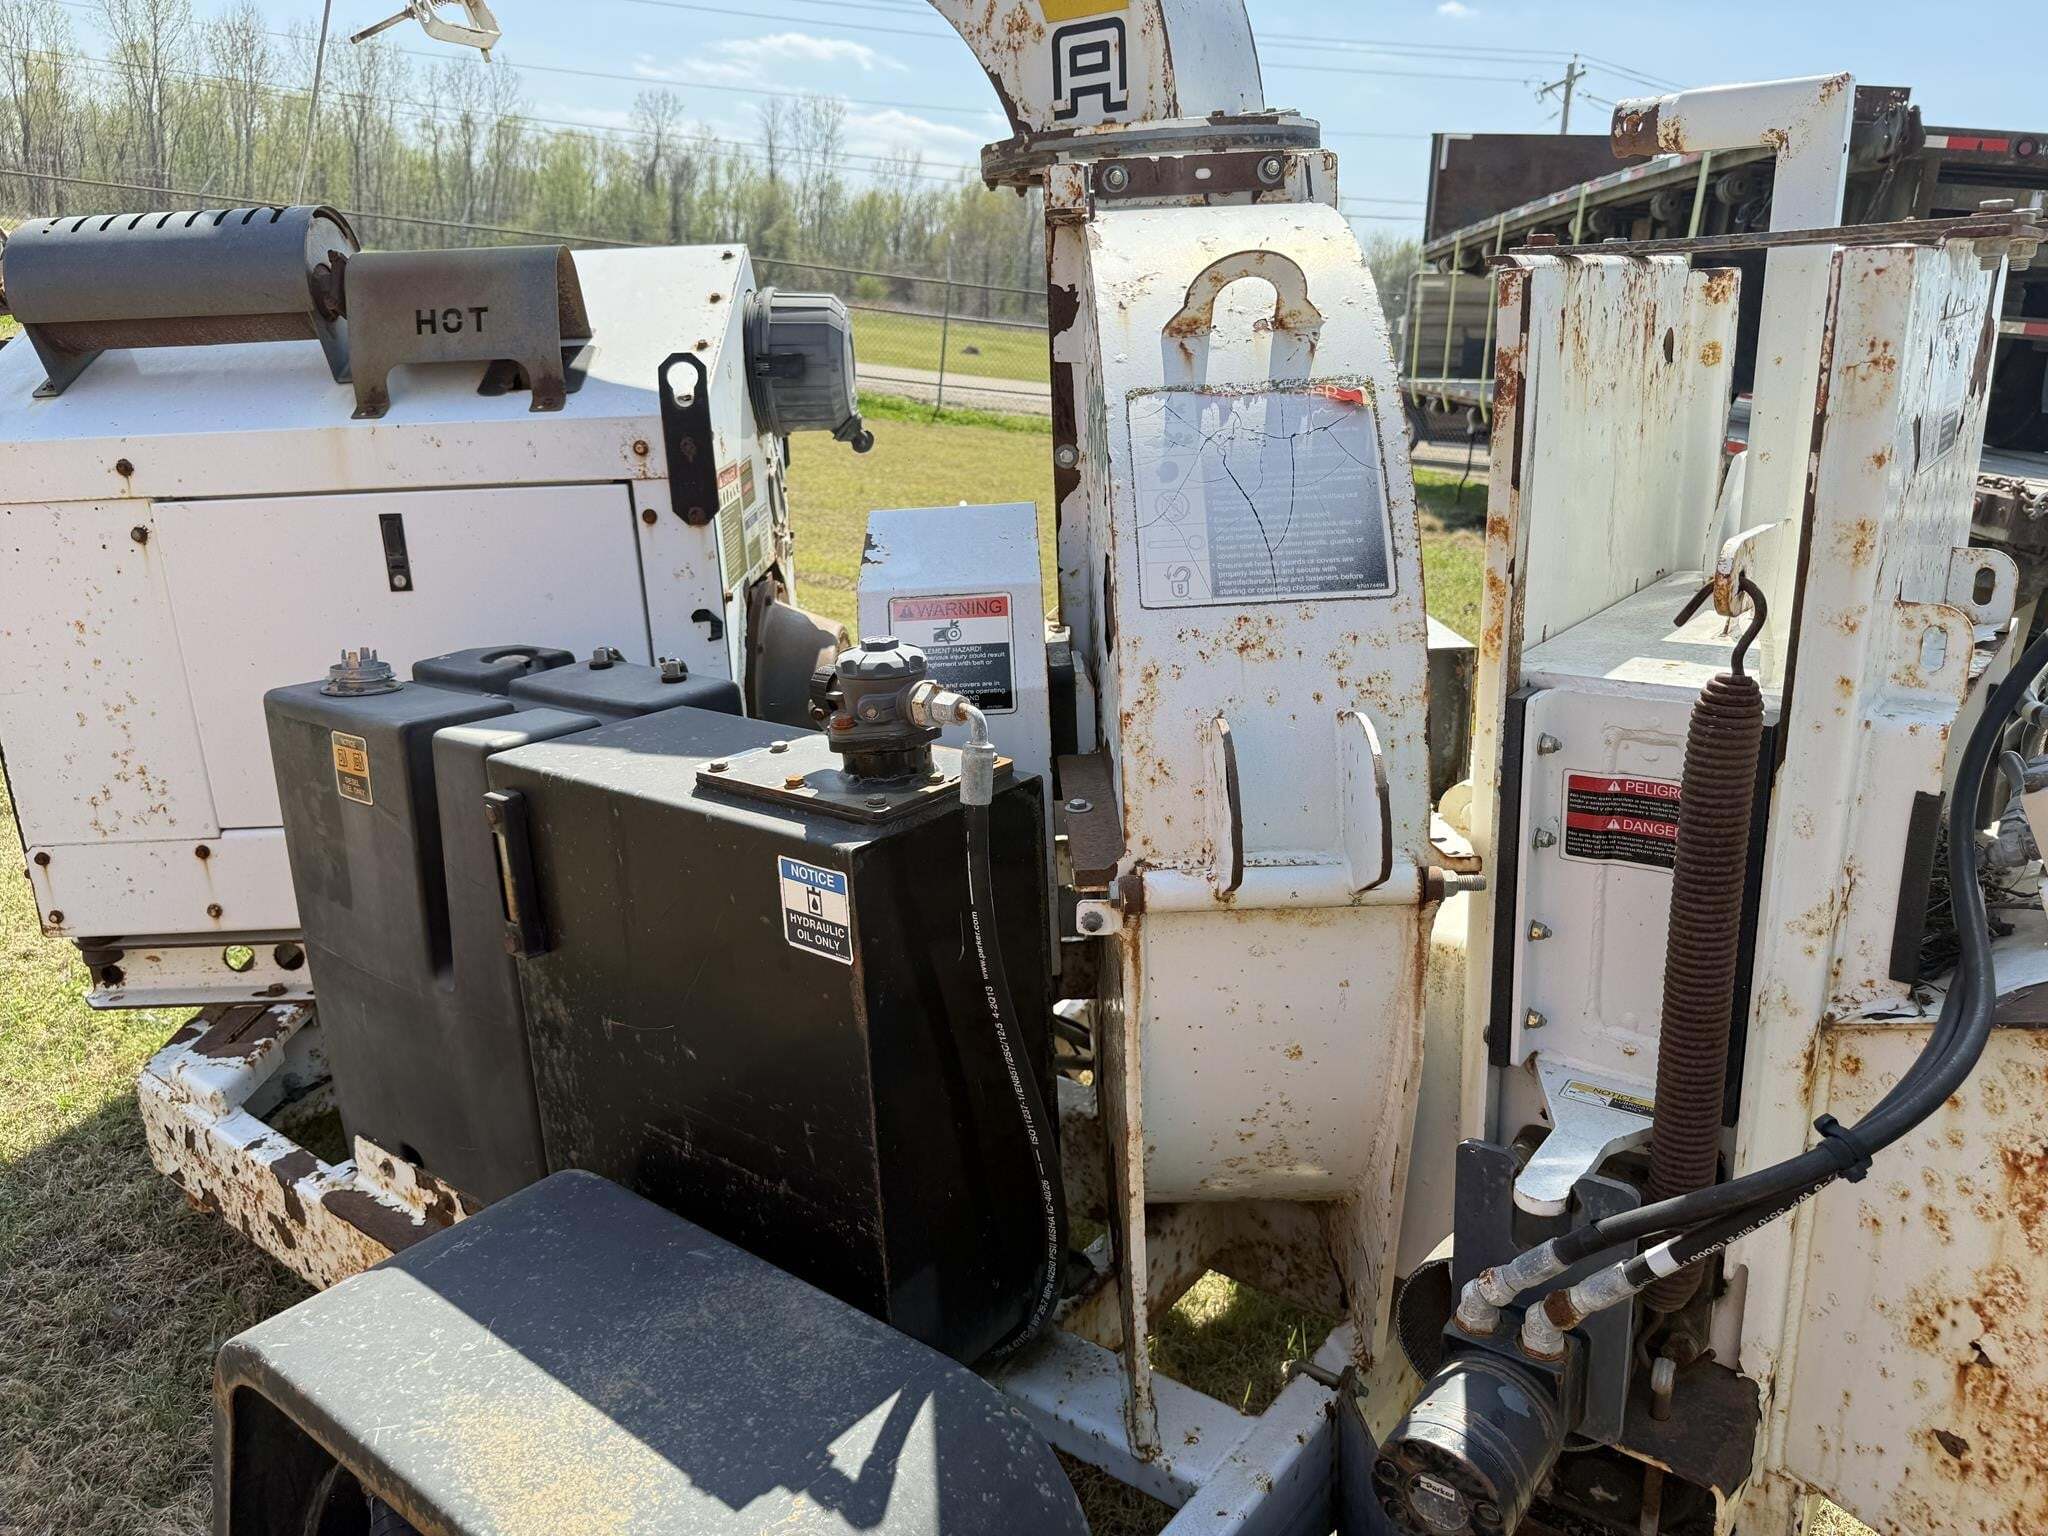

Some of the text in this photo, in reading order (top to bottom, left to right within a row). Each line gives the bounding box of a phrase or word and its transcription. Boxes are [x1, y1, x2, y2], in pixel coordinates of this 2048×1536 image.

[416, 306, 489, 336] HOT
[916, 599, 1003, 618] WARNING
[950, 653, 967, 661] injury
[953, 645, 982, 653] HAZARD!
[791, 864, 835, 887] NOTICE
[790, 913, 845, 938] HYDRAULIC
[797, 928, 840, 951] OIL ONLY
[971, 911, 989, 980] www.parker.com
[1593, 1087, 1637, 1102] NOTICE
[1047, 1216, 1058, 1241] MSHA
[1421, 1481, 1454, 1499] Parker
